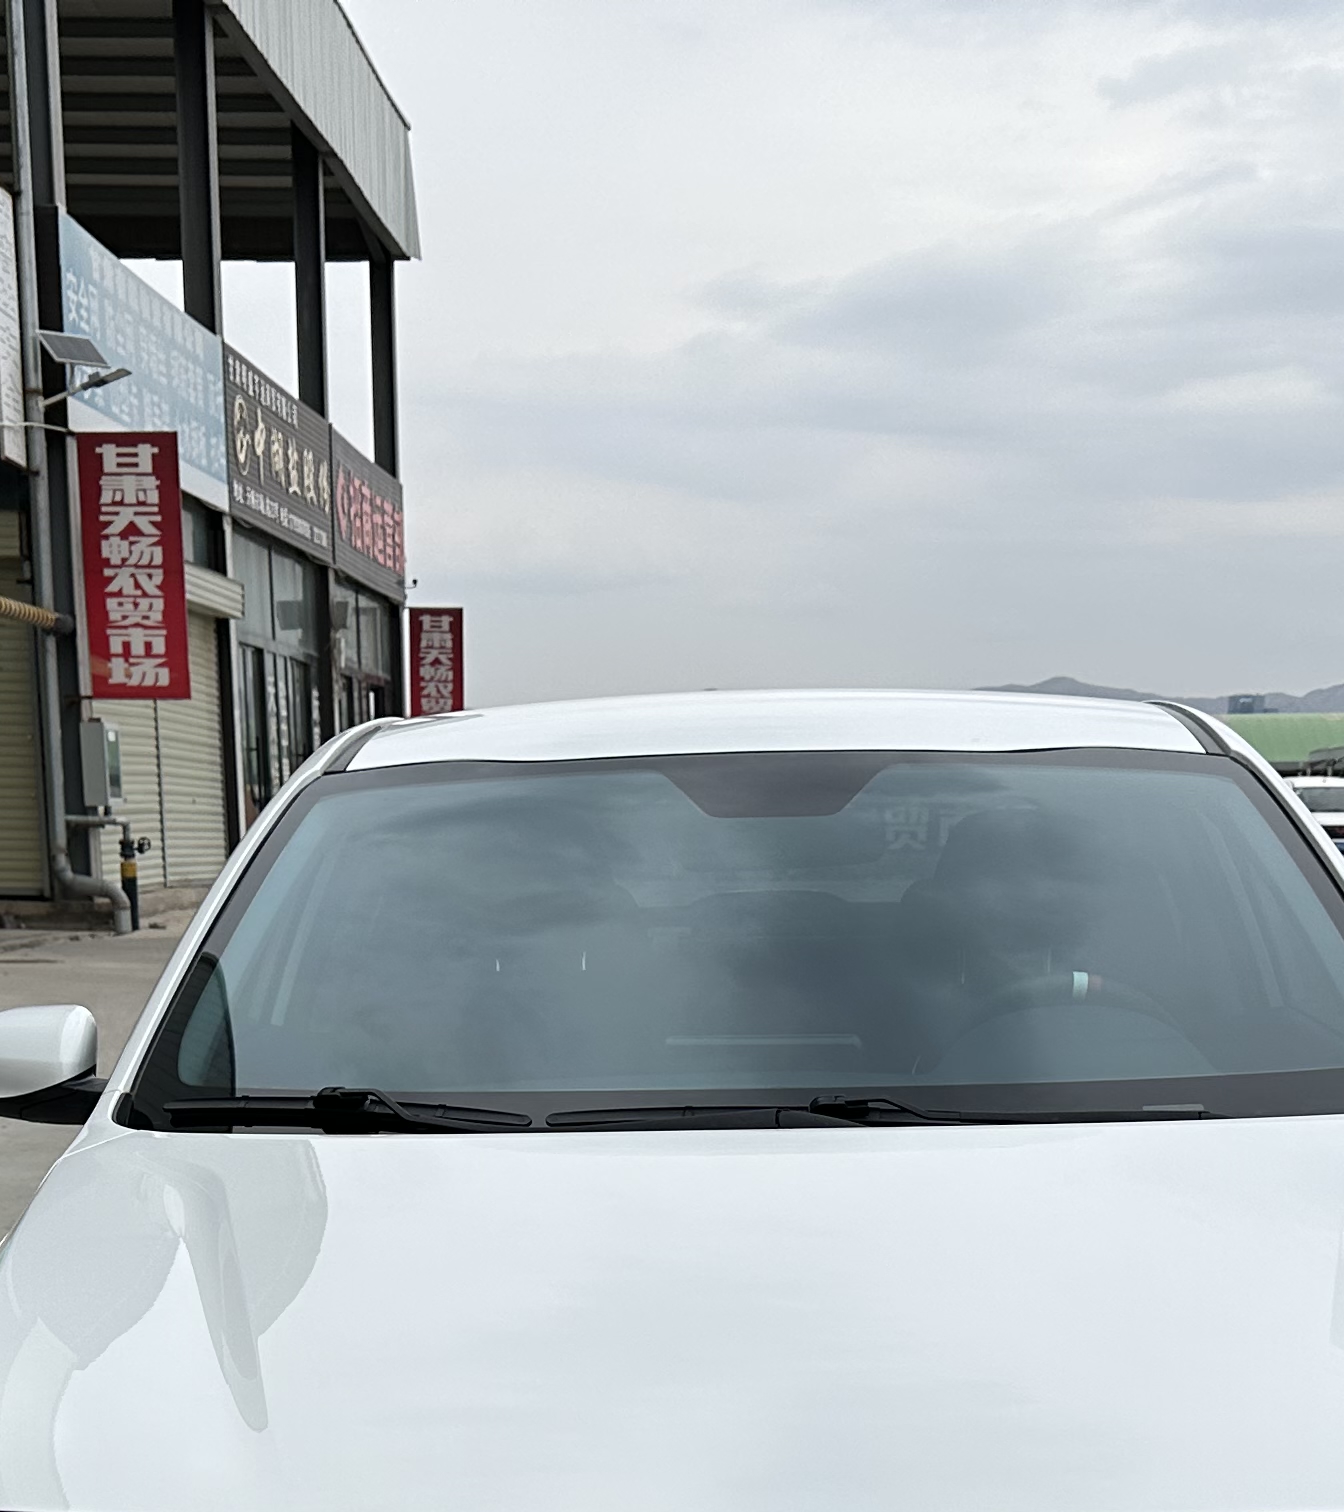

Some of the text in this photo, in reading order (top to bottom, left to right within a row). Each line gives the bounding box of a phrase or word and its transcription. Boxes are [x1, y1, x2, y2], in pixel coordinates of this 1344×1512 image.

[95, 443, 170, 687] 甘肃天畅农贸市场
